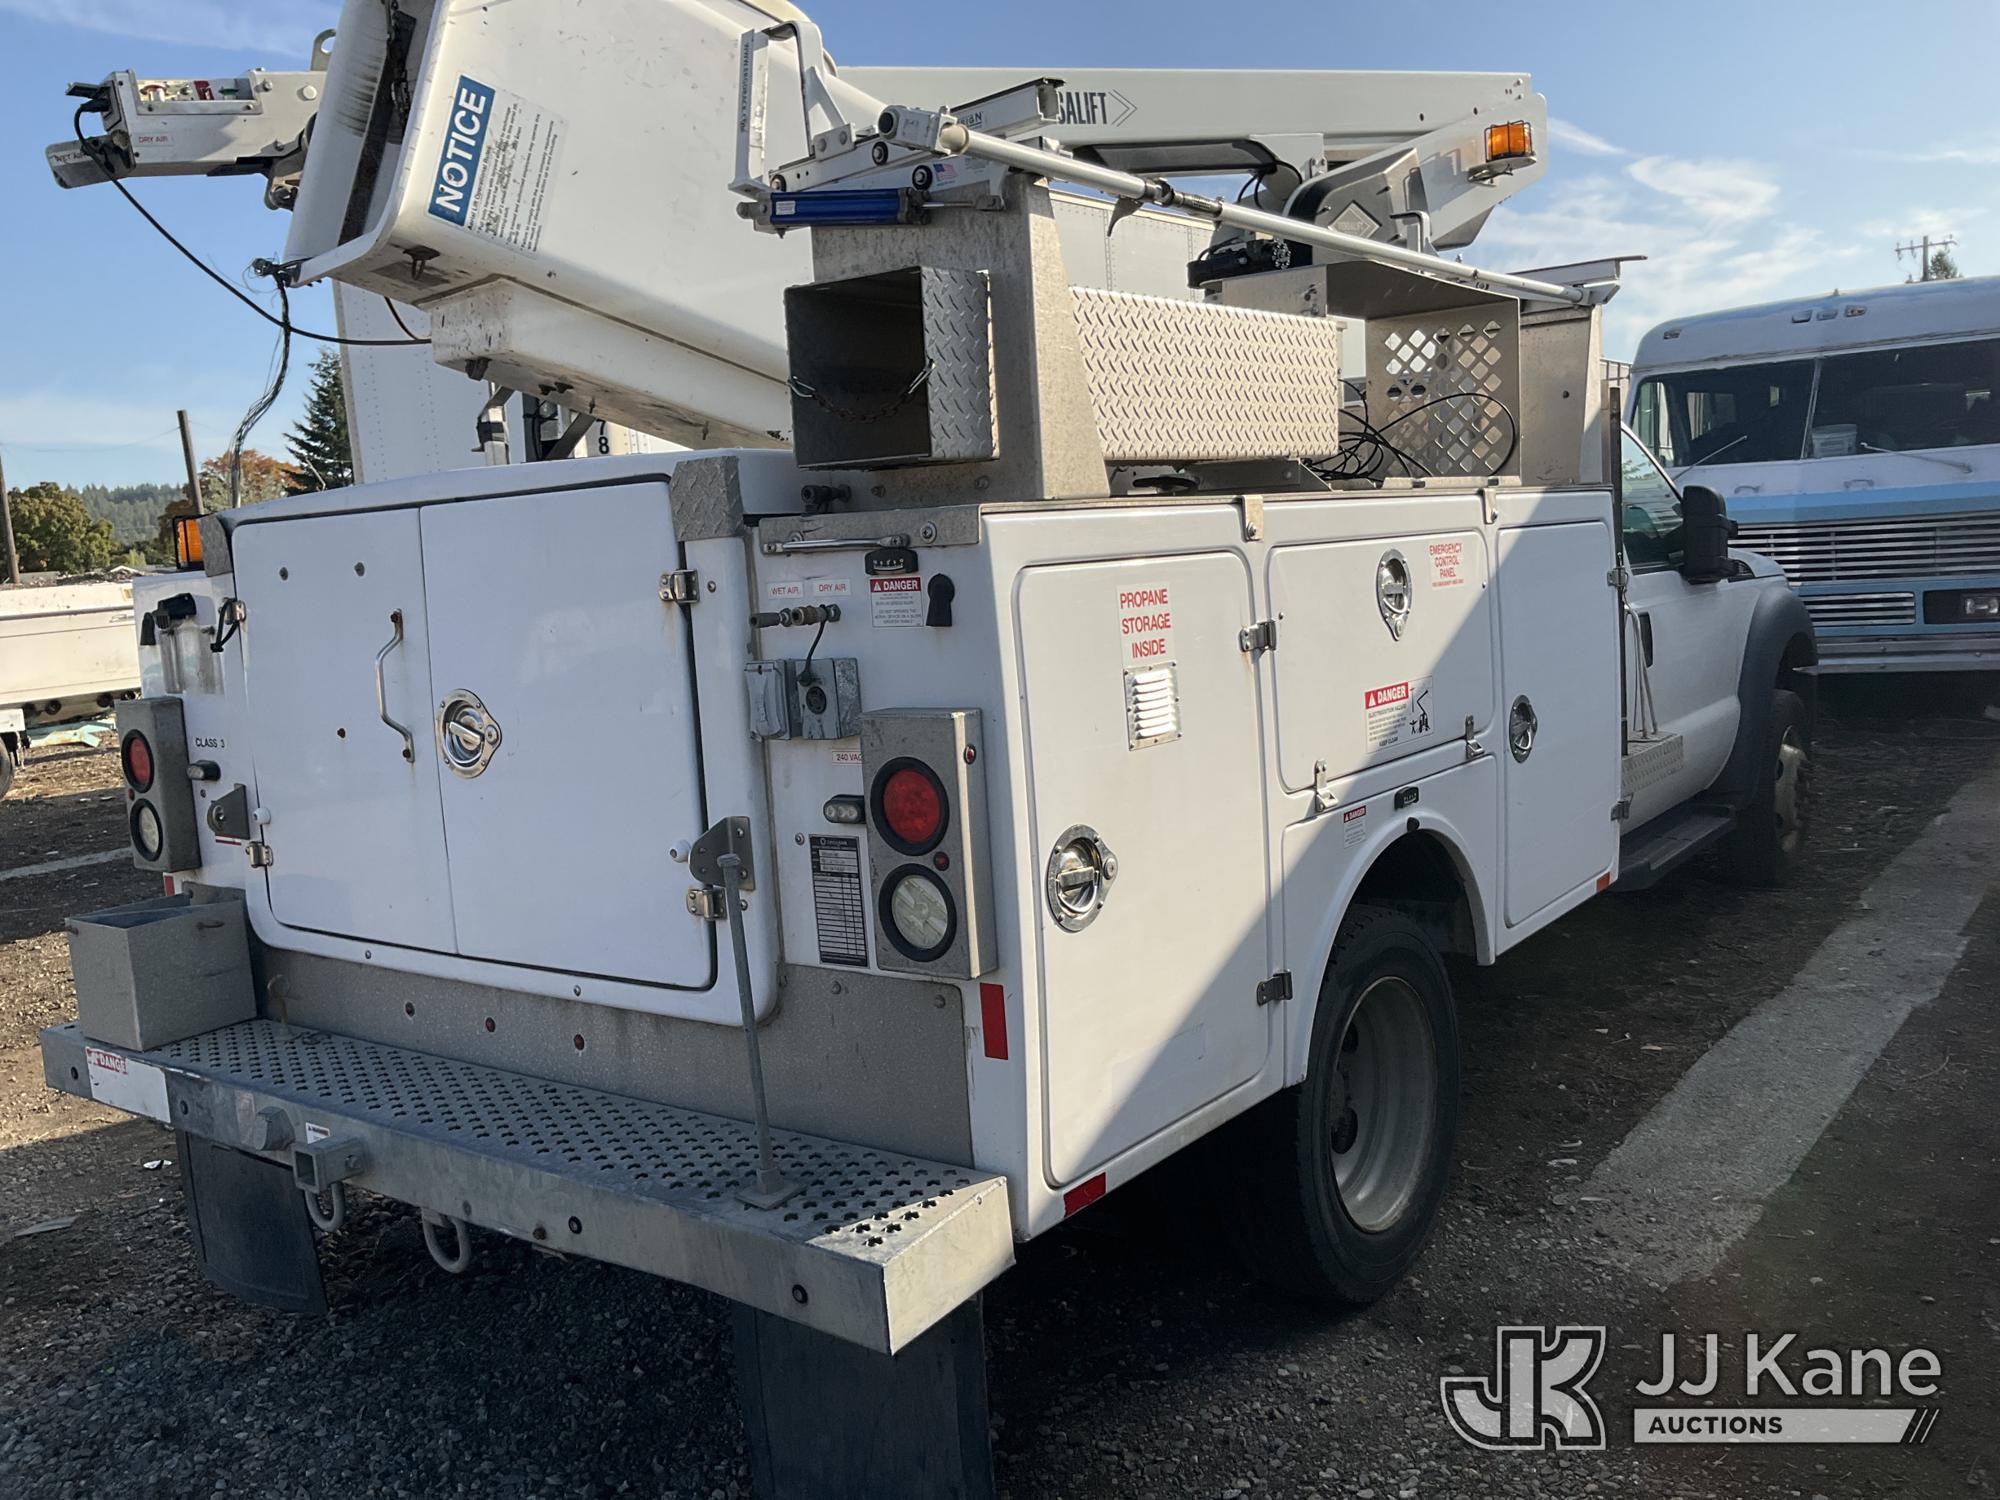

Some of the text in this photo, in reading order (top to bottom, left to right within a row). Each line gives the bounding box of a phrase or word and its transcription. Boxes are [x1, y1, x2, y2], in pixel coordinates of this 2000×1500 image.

[436, 88, 486, 213] NOTICE
[1430, 543, 1462, 556] EMERGENCY
[1435, 555, 1460, 568] CONTROL
[1440, 567, 1456, 578] PANEL
[883, 580, 918, 590] DANGER
[1120, 589, 1168, 609] PROPANE
[1122, 613, 1171, 634] STORAGE
[1132, 638, 1166, 658] INSIDE
[1378, 685, 1406, 704] DANGER
[196, 738, 225, 748] CLASS 3
[1349, 808, 1364, 820] DANGER
[100, 1054, 128, 1073] DANGE
